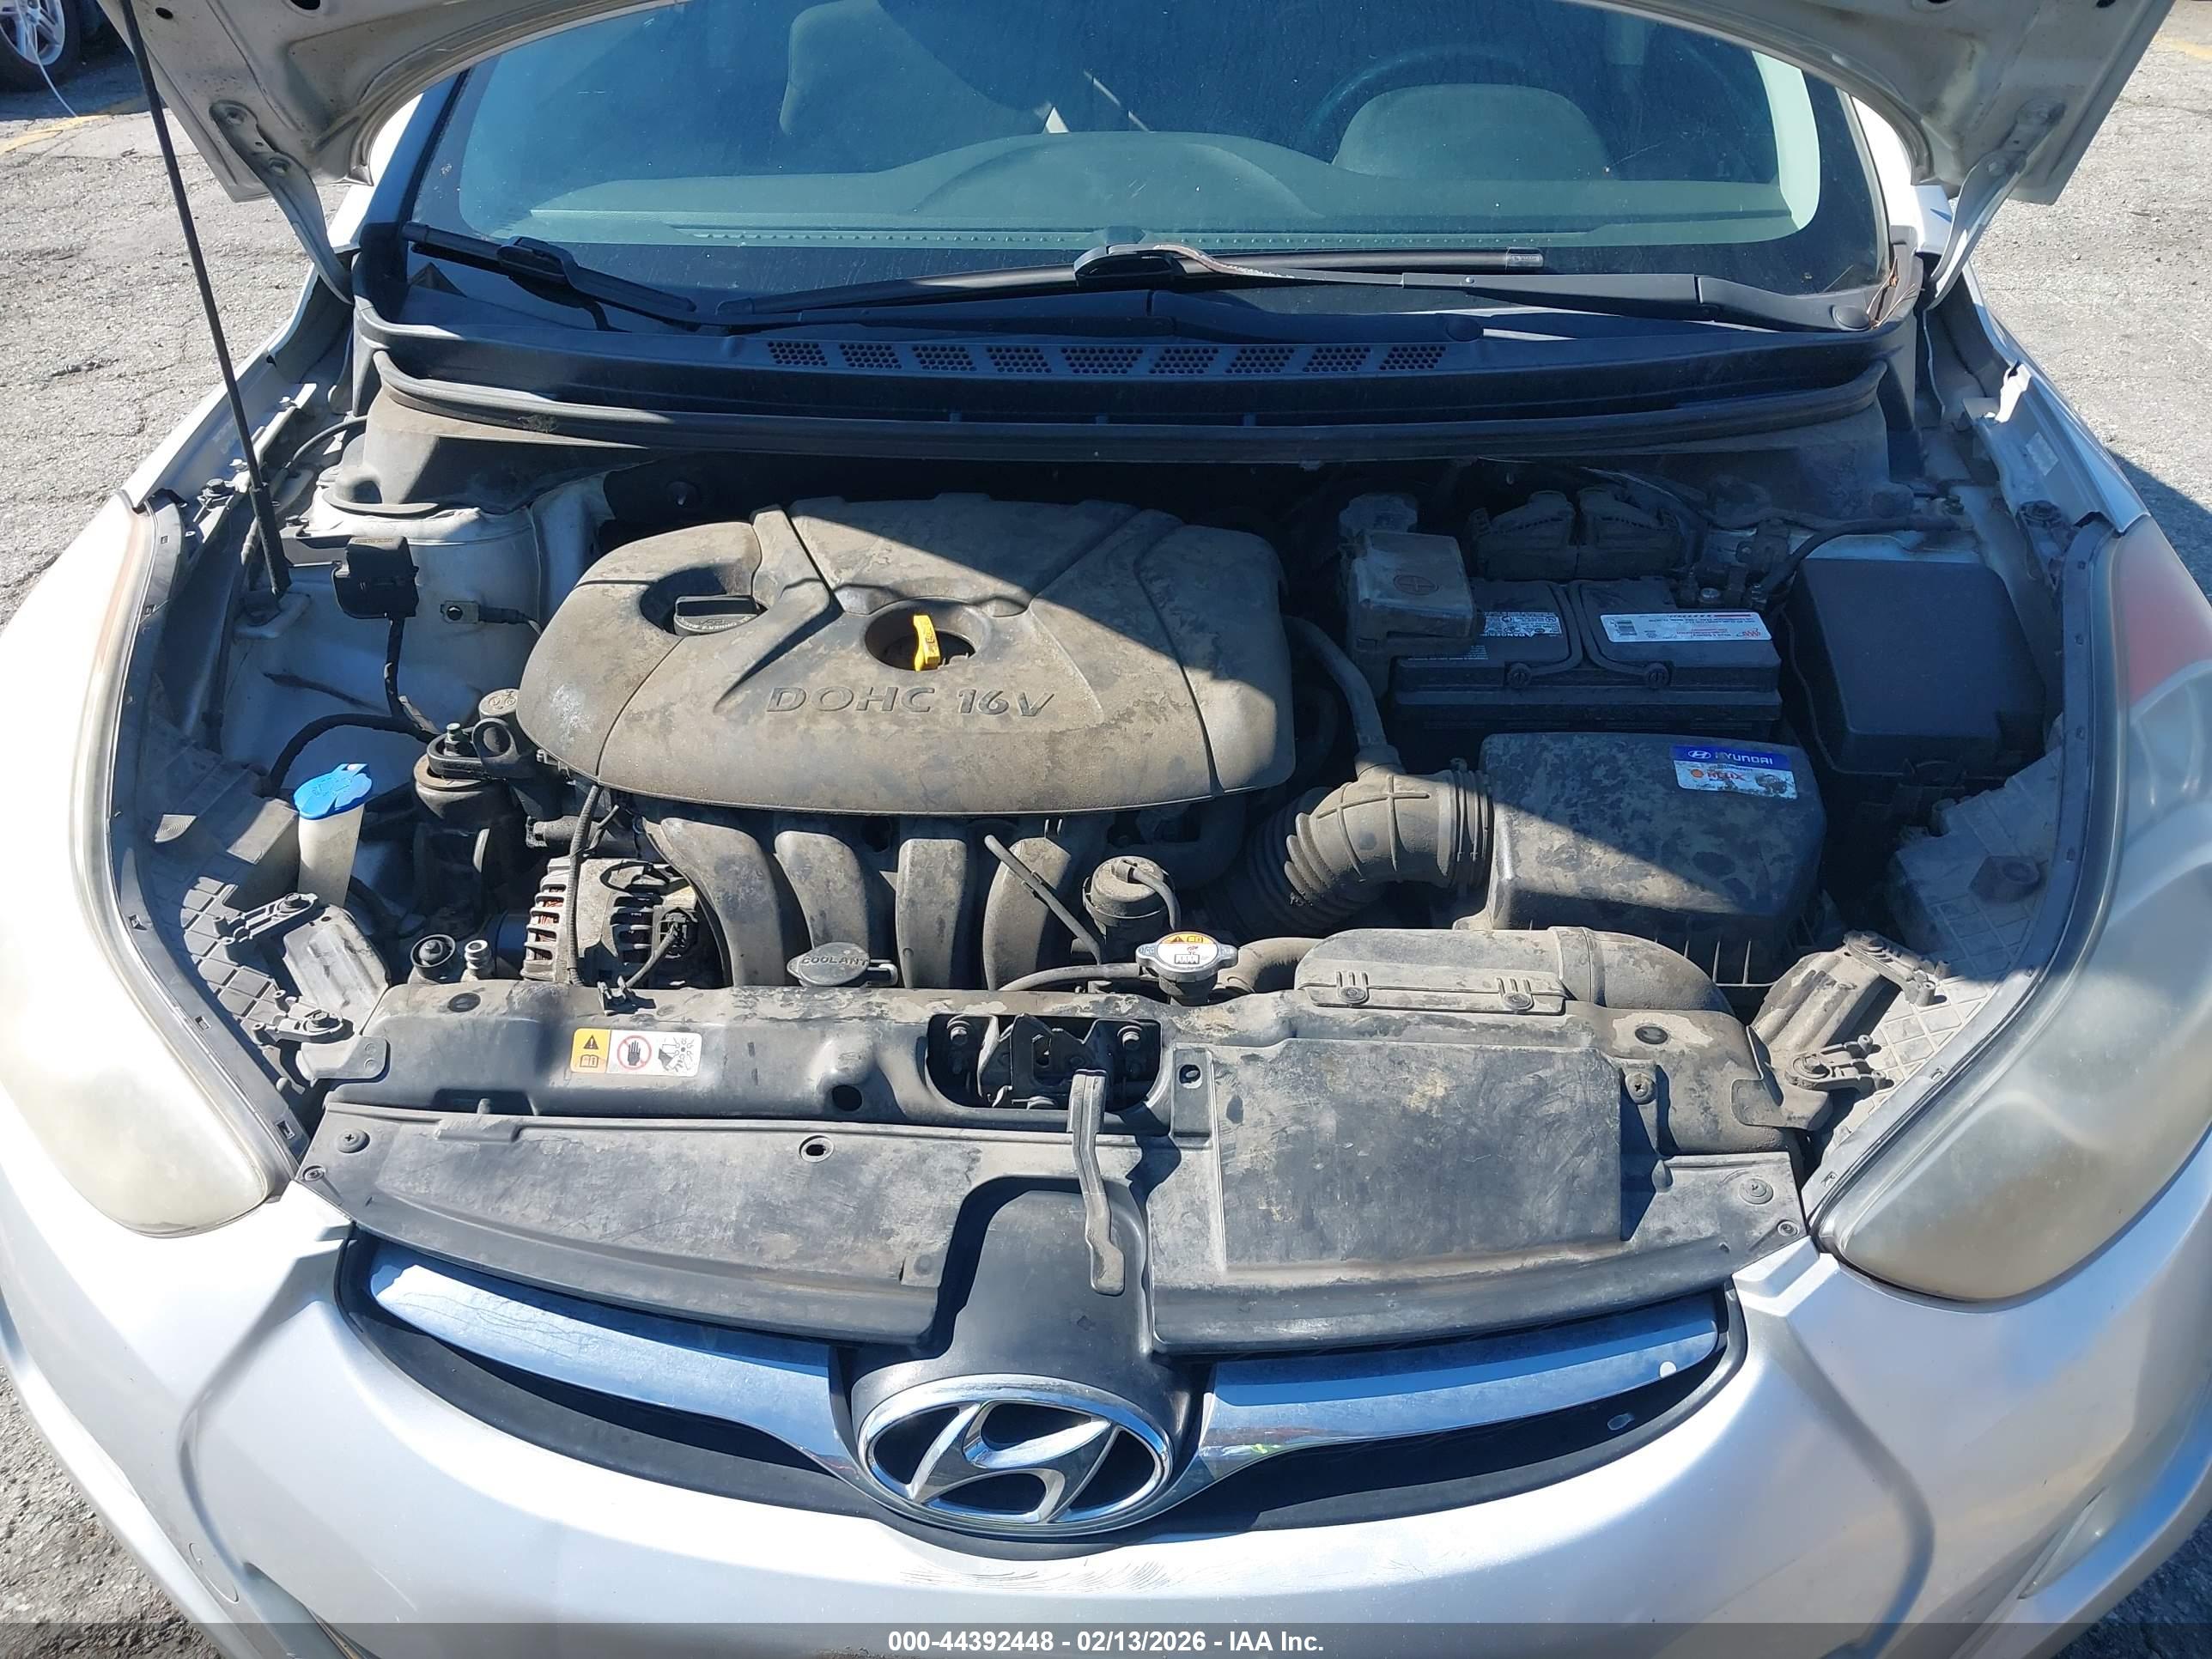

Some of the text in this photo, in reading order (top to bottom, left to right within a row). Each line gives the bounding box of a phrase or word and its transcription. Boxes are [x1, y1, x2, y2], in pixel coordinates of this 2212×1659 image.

[766, 686, 1055, 717] DOHC 16V
[1715, 751, 1773, 765] YUNDAI
[801, 956, 869, 967] COOLANT
